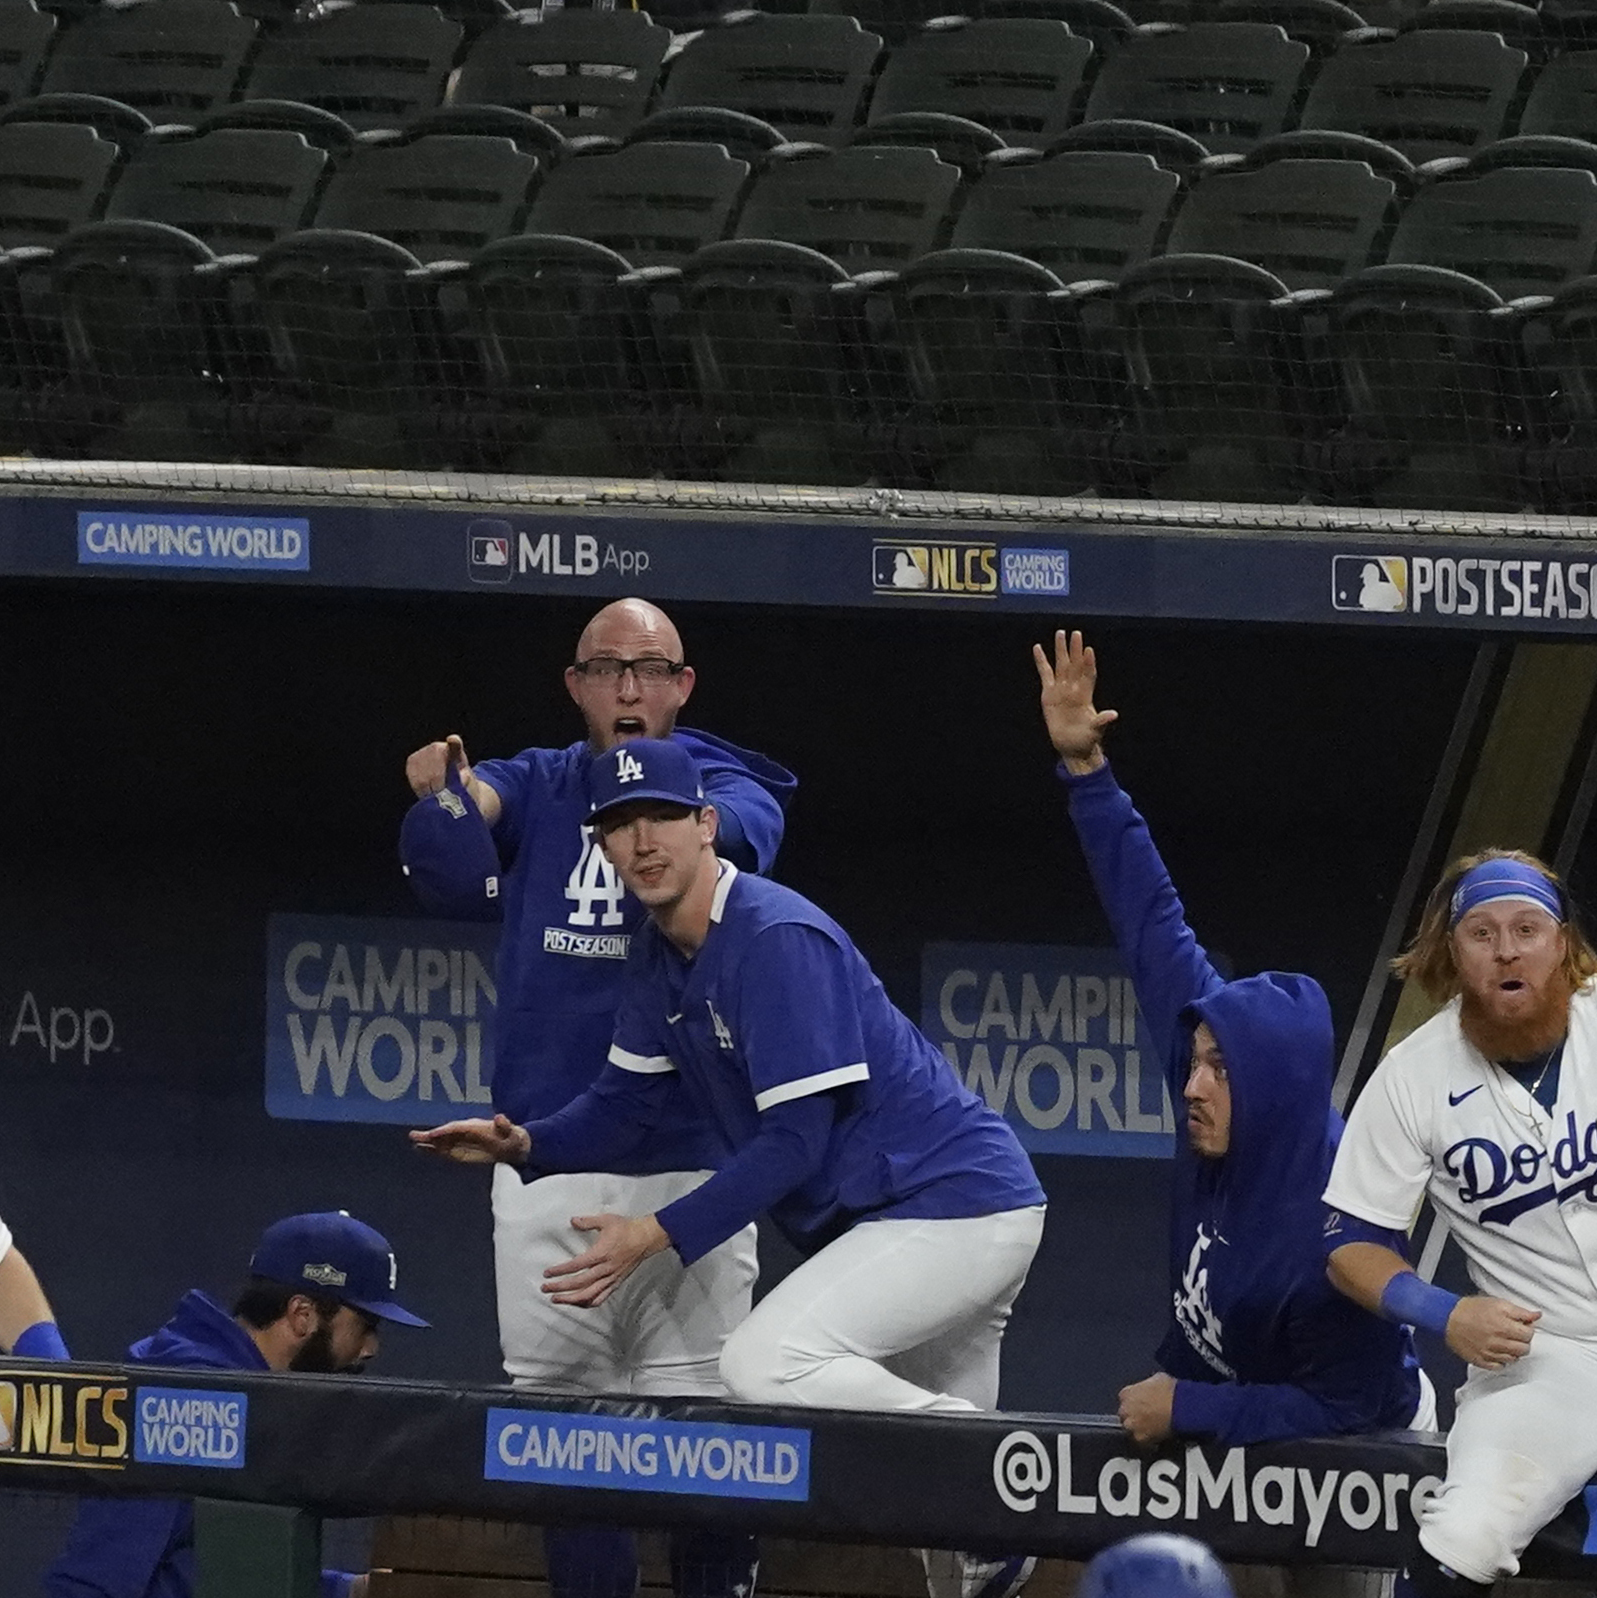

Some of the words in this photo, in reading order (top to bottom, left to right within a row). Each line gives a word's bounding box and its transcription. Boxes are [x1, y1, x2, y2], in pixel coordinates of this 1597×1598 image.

[86, 523, 202, 557] CAMPING
[206, 527, 301, 560] WORLD
[518, 533, 599, 576] MLB
[603, 543, 649, 576] App
[1004, 553, 1065, 572] CAMPING
[932, 547, 998, 592] NLCS
[1006, 571, 1066, 590] WORLD
[616, 749, 644, 783] LA
[284, 942, 497, 1018] CAMPIN
[9, 989, 116, 1065] App
[284, 1014, 494, 1104] WORL
[20, 1382, 128, 1459] NLCS
[141, 1398, 240, 1429] CAMPING
[143, 1422, 240, 1461] WORLD
[498, 1422, 658, 1478] CAMPING
[664, 1434, 801, 1485] WORLD
[993, 1430, 1446, 1548] @LasMayore
